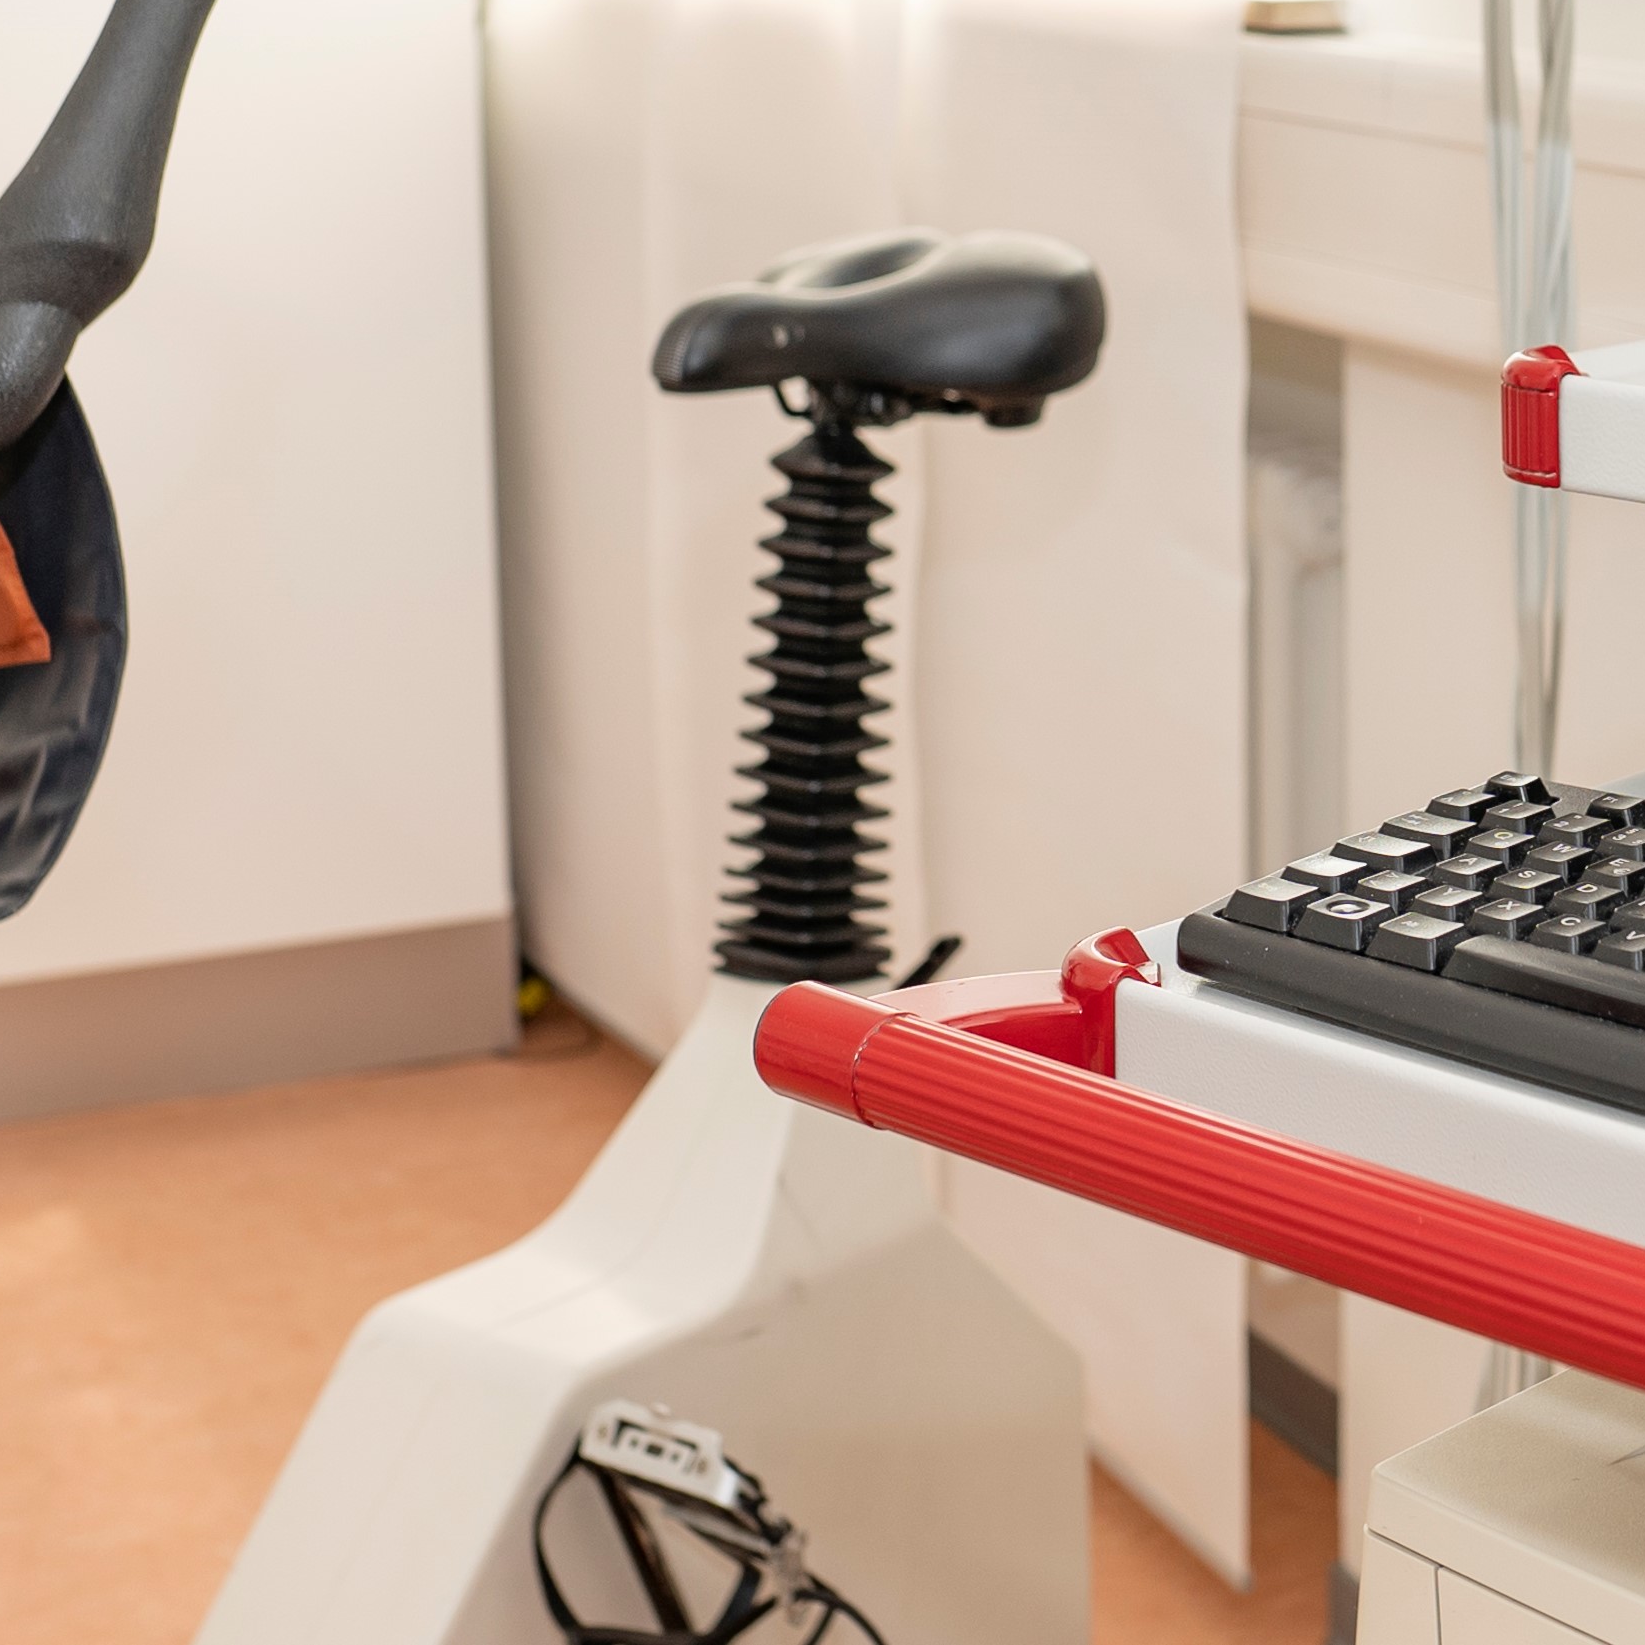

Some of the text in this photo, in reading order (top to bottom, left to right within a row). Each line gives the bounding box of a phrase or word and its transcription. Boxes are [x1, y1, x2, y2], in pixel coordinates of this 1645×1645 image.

[1603, 795, 1619, 804] F1
[1494, 831, 1514, 841] Q
[1551, 843, 1576, 854] W
[1517, 870, 1535, 881] S
[1443, 887, 1463, 898] Y
[1576, 883, 1598, 894] D
[1497, 900, 1520, 911] X
[1559, 915, 1582, 927] C
[1625, 930, 1645, 942] V
